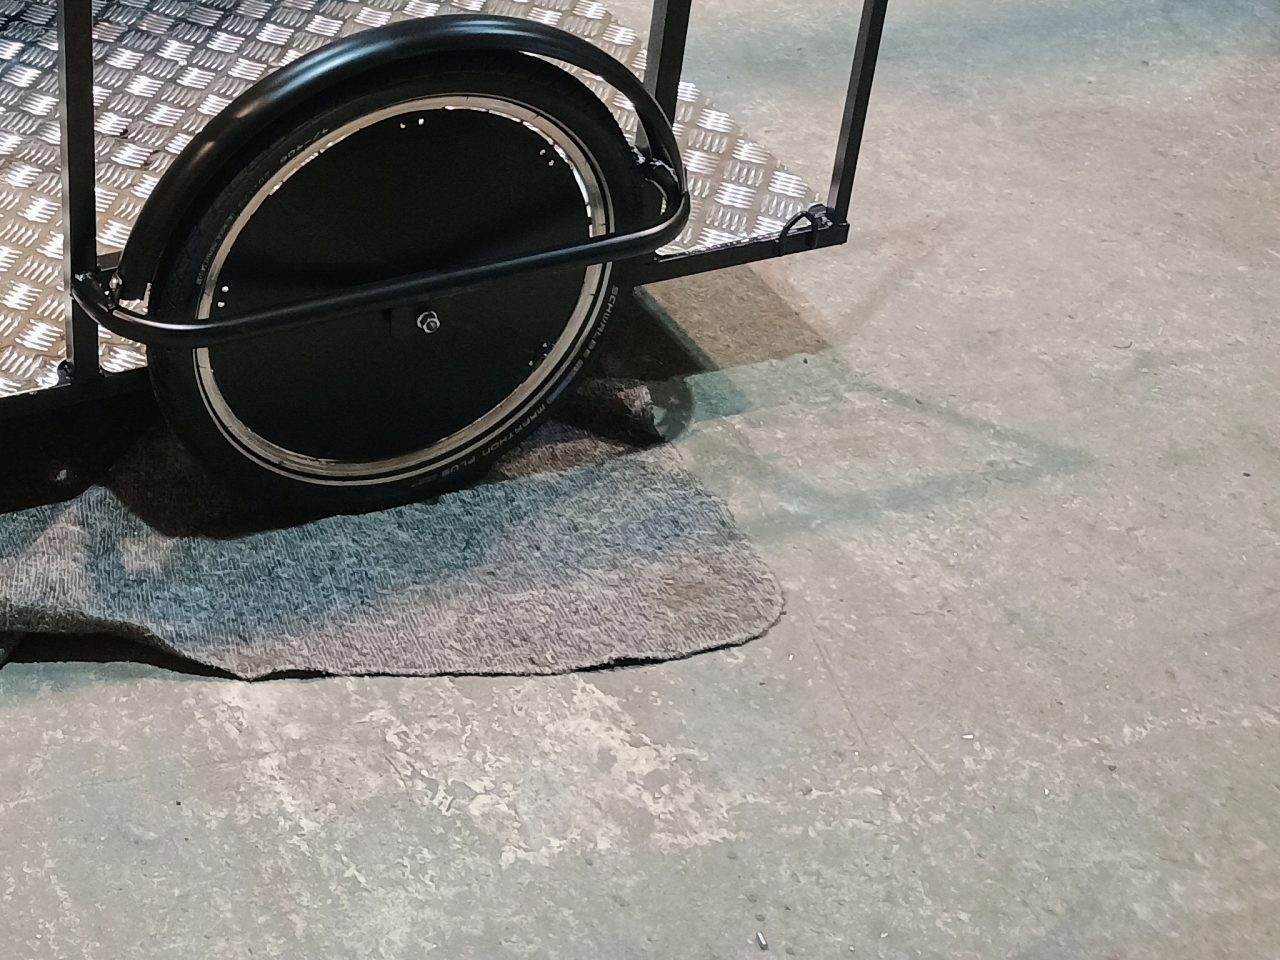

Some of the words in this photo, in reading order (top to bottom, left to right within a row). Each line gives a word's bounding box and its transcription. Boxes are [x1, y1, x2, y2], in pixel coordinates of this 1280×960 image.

[582, 284, 619, 359] SCHWALBE
[481, 403, 546, 457] MARATHON
[440, 455, 476, 477] PLUS
